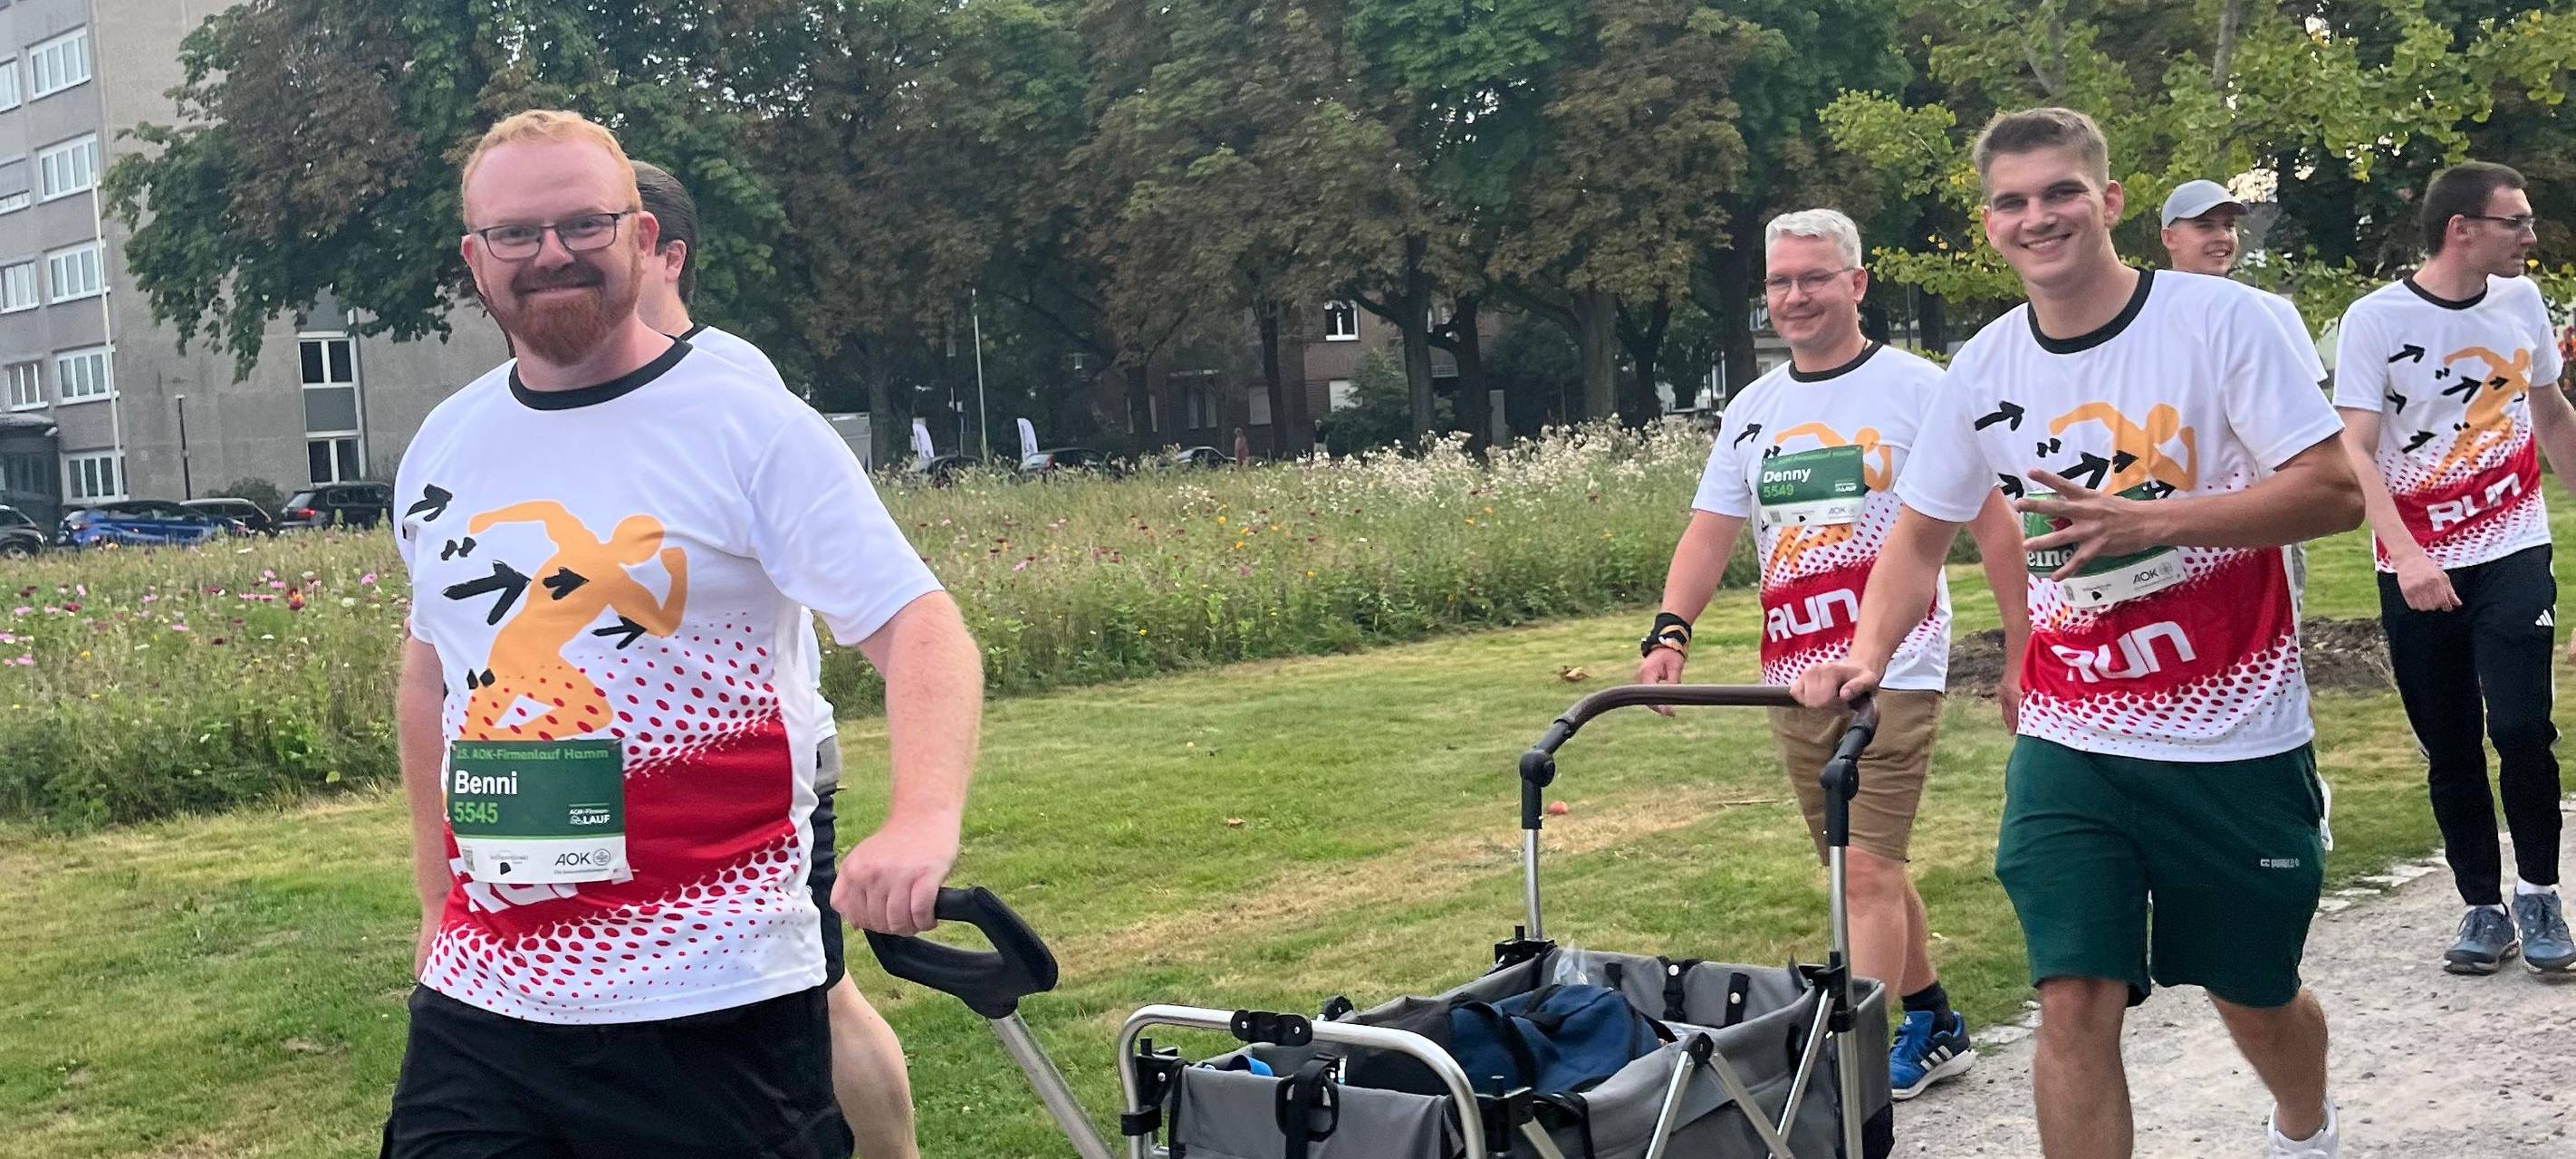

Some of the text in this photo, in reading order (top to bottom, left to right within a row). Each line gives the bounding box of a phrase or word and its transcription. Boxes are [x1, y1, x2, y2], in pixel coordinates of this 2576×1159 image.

[1763, 468, 1811, 483] Denny
[1764, 484, 1794, 498] 5549
[2133, 568, 2158, 584] AOK
[472, 748, 561, 761] AOK-Firmenlauf
[564, 748, 609, 759] Hamm
[455, 770, 517, 795] Benni
[454, 801, 498, 824] 5545
[583, 815, 610, 824] LAUF
[555, 852, 591, 866] AOK
